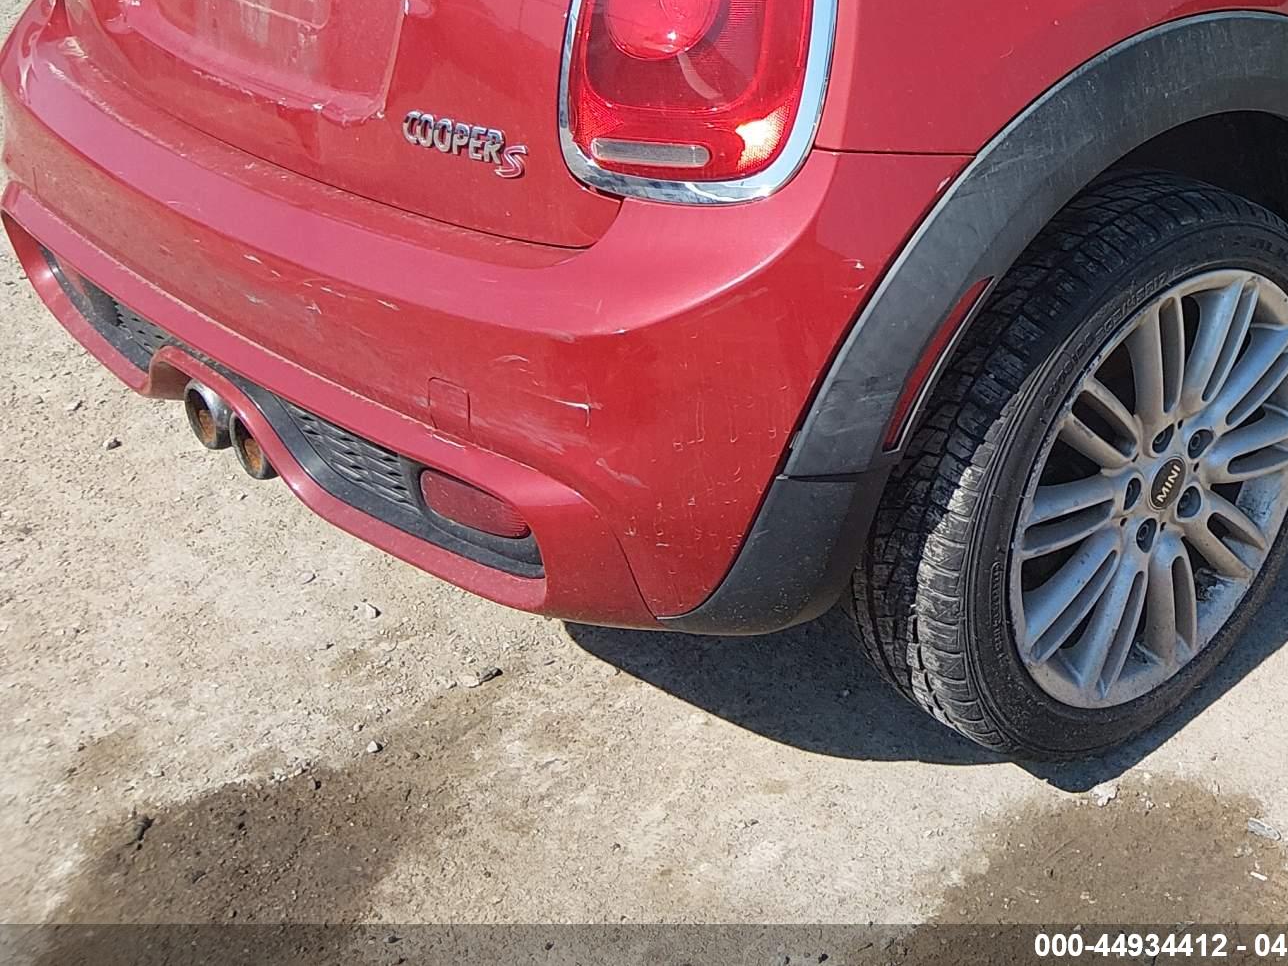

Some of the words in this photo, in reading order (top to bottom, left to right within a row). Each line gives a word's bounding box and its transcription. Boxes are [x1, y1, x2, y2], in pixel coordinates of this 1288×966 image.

[402, 110, 505, 165] COOPER
[494, 145, 528, 178] S
[1156, 464, 1181, 503] MINI
